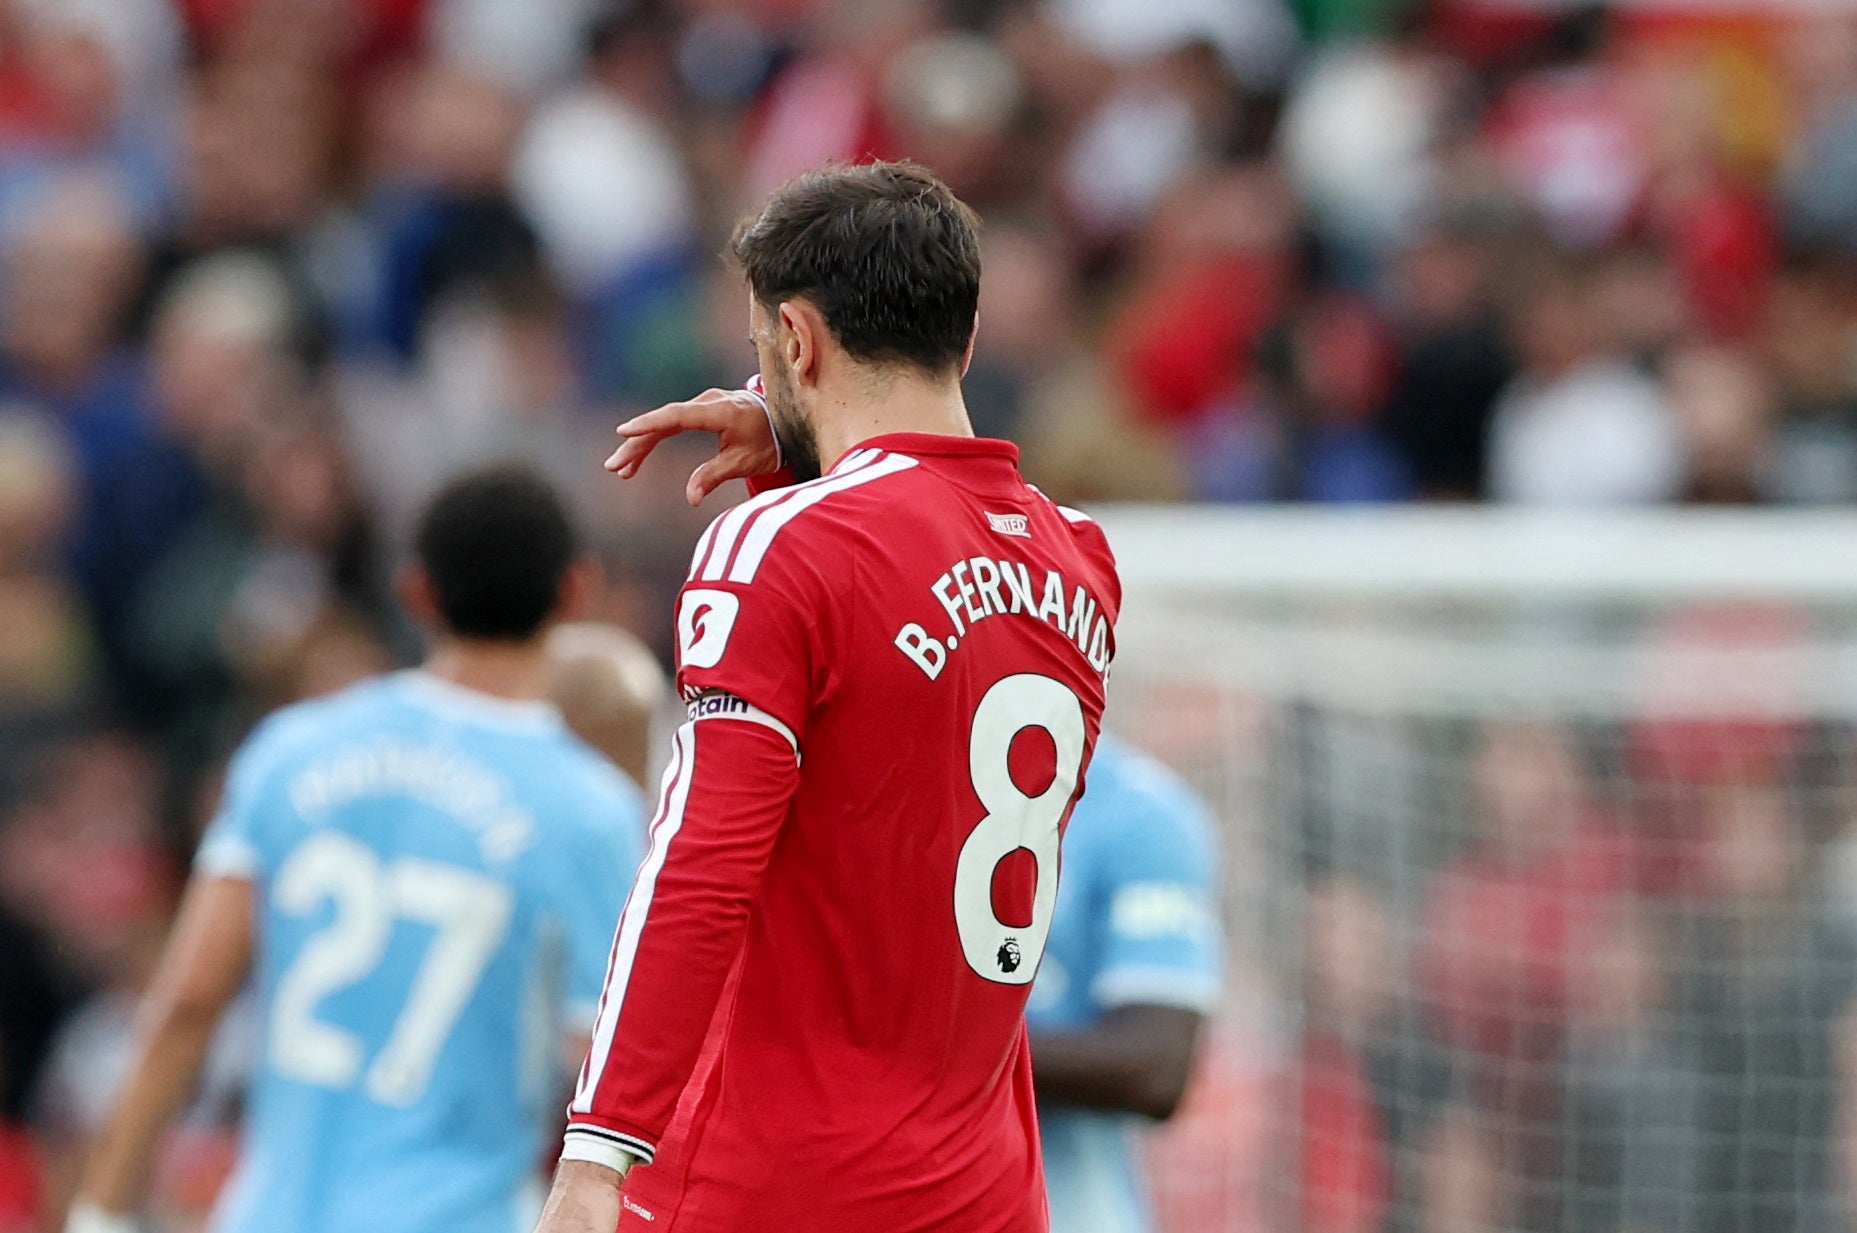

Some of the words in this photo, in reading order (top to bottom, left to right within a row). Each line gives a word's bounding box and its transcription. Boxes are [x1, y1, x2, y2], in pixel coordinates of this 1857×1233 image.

[894, 556, 1111, 692] B.FERNAND
[954, 672, 1086, 985] 8
[271, 830, 514, 1108] 27
